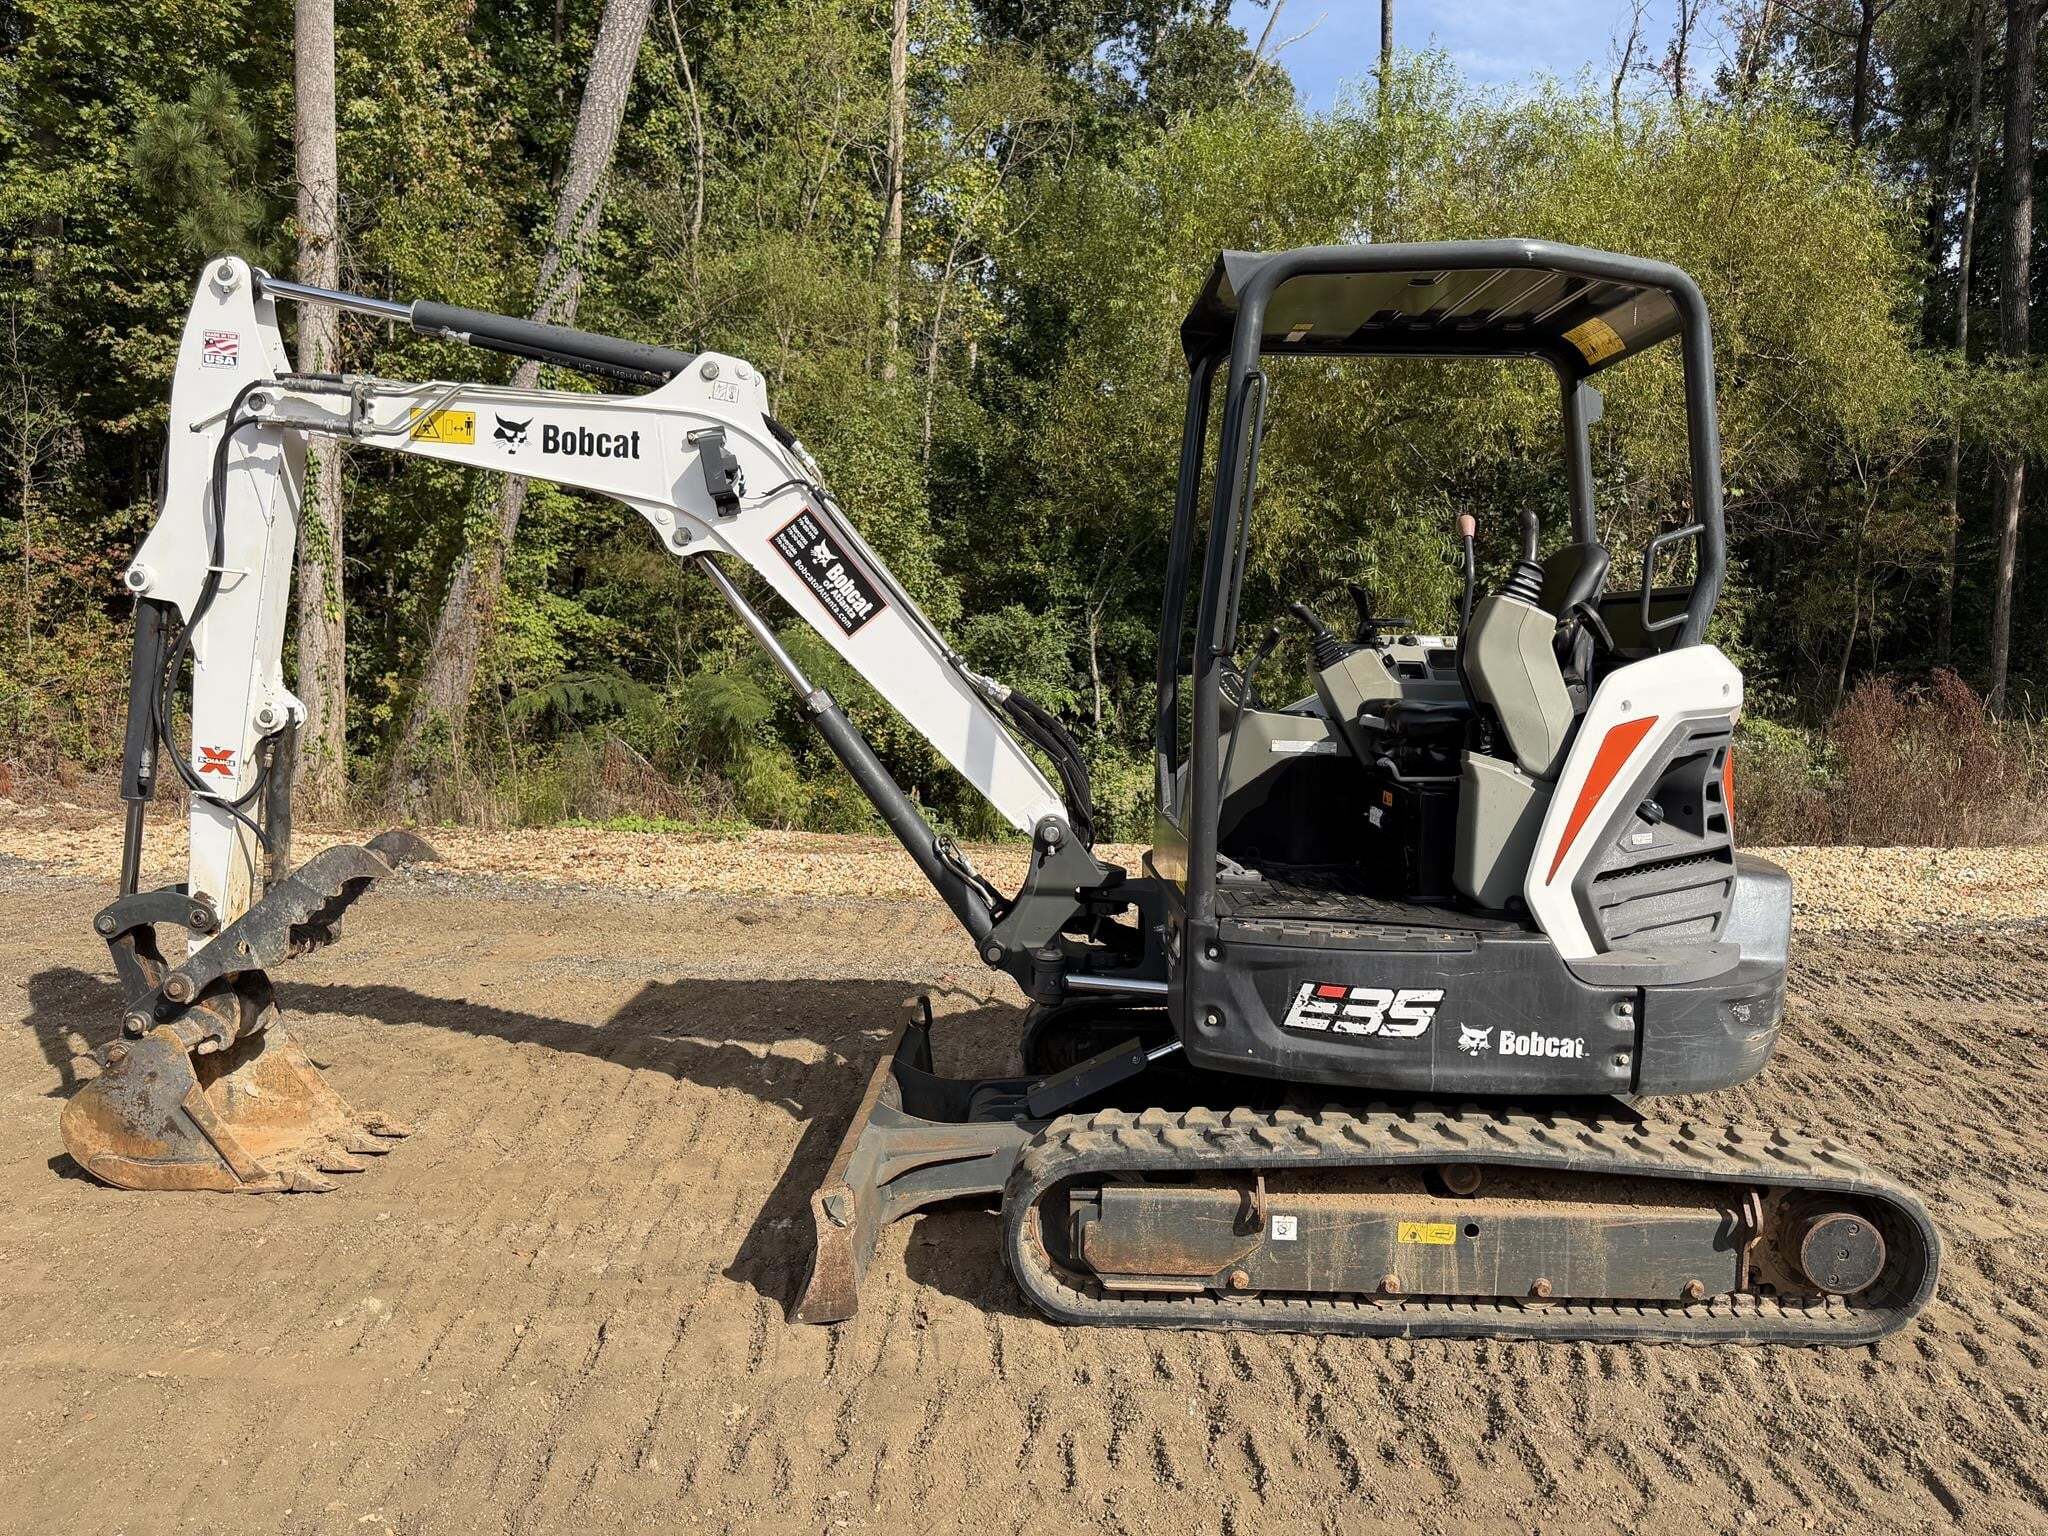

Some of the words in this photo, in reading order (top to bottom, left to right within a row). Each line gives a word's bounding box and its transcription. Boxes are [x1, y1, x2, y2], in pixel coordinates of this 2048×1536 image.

[204, 354, 236, 365] USA
[542, 424, 640, 460] Bobcat
[794, 559, 852, 629] BobcatofAtlanta.com
[822, 580, 835, 590] of
[830, 589, 857, 619] Atlanta
[1283, 983, 1446, 1038] E35
